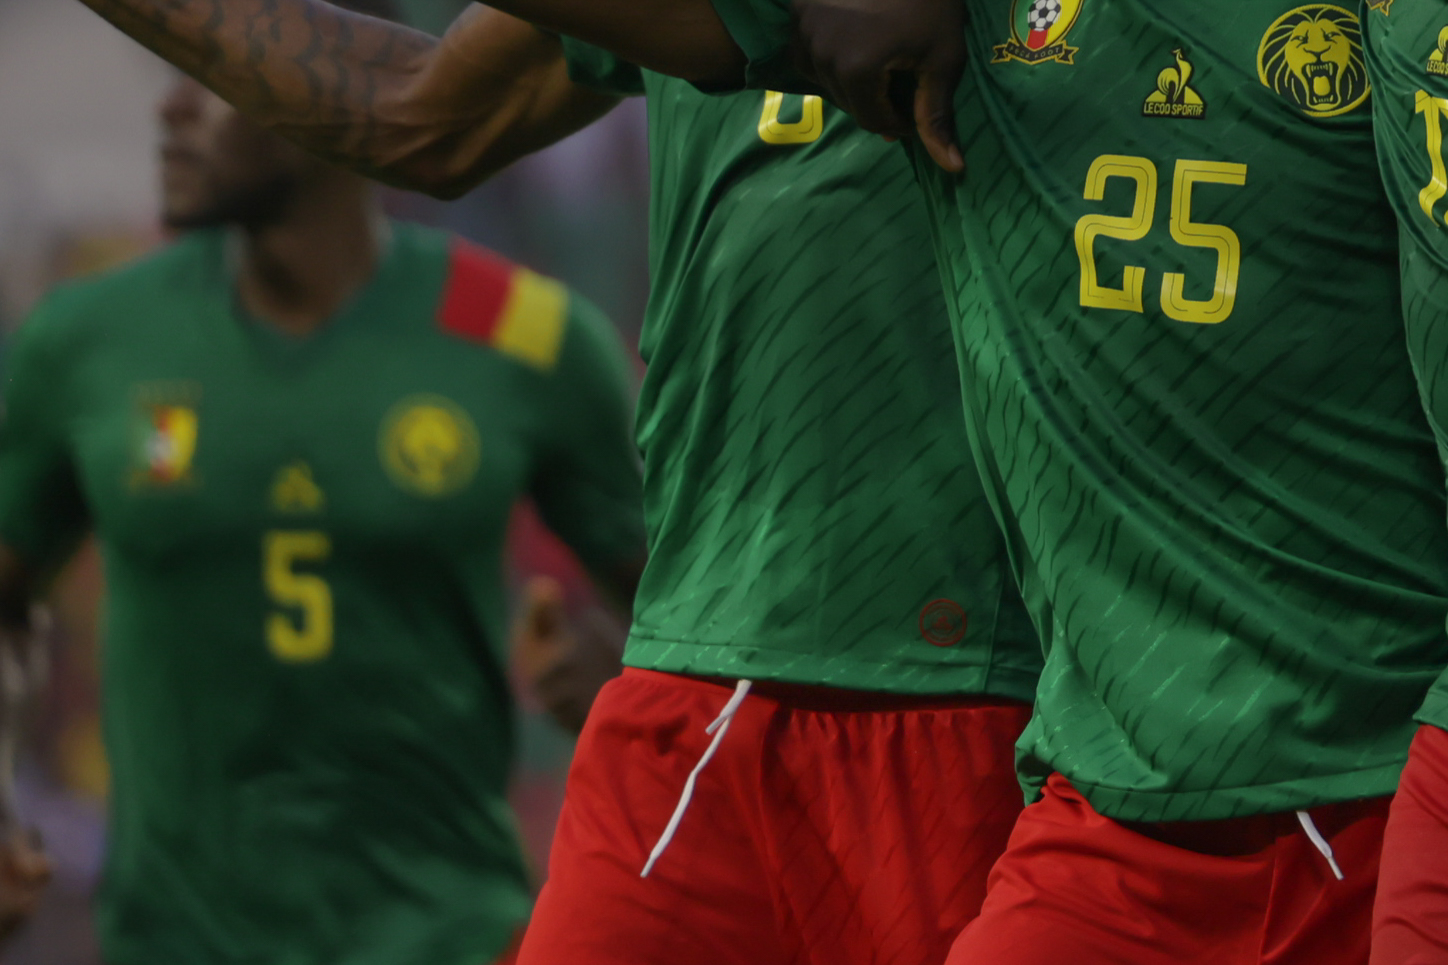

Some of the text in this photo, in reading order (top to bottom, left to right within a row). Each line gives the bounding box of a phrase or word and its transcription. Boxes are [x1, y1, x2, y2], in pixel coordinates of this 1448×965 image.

[1171, 103, 1203, 116] SPORTIF
[1074, 154, 1248, 324] 25
[263, 531, 333, 663] 5
